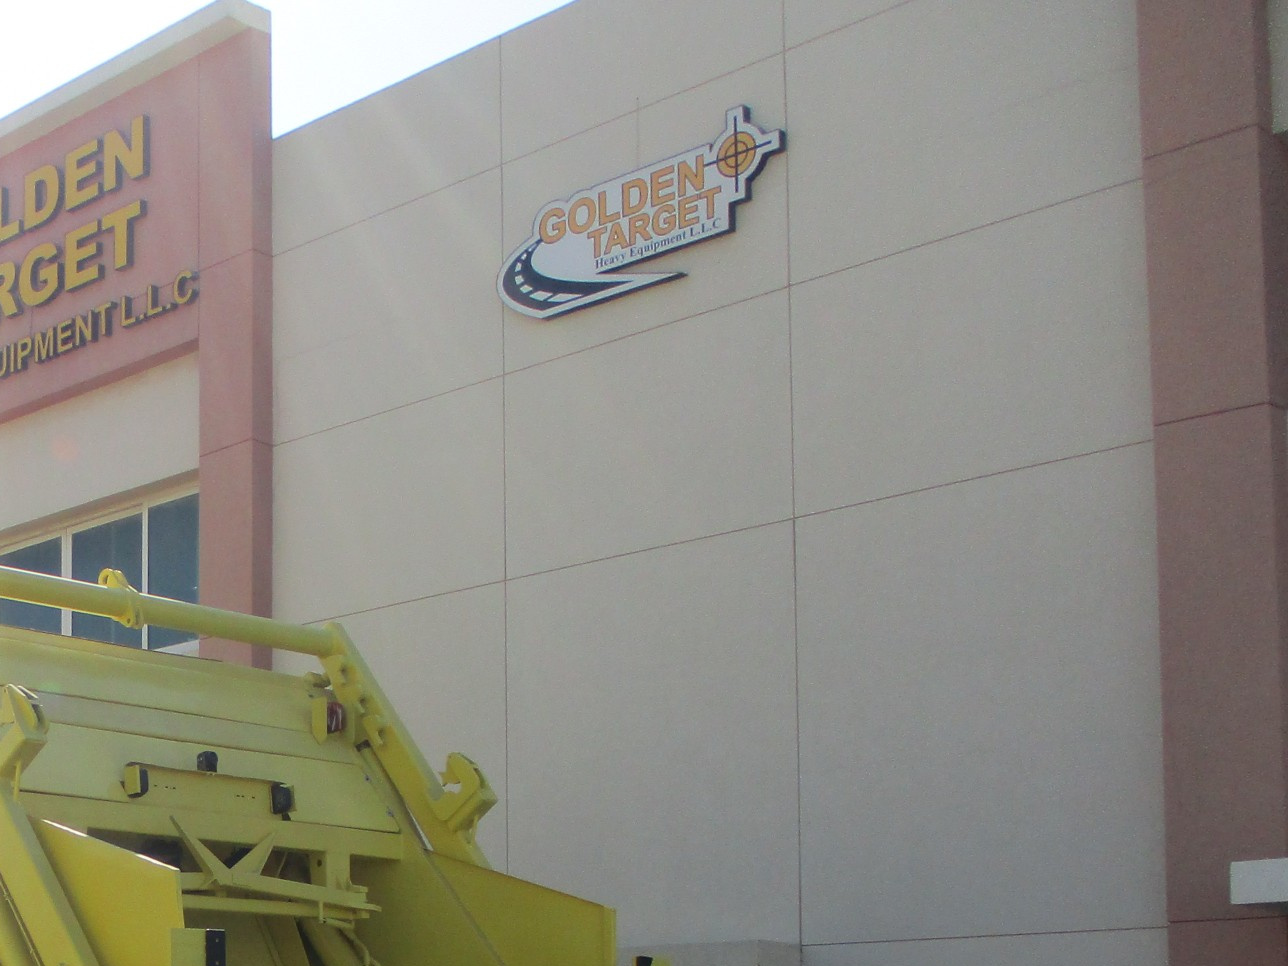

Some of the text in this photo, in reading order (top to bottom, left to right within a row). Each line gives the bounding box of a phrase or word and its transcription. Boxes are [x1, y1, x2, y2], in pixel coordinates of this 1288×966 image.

[539, 154, 705, 244] GOLDEN
[587, 185, 722, 258] TARGET
[595, 252, 627, 269] Heavy
[630, 229, 687, 258] Equipment
[120, 270, 198, 327] L.L.C
